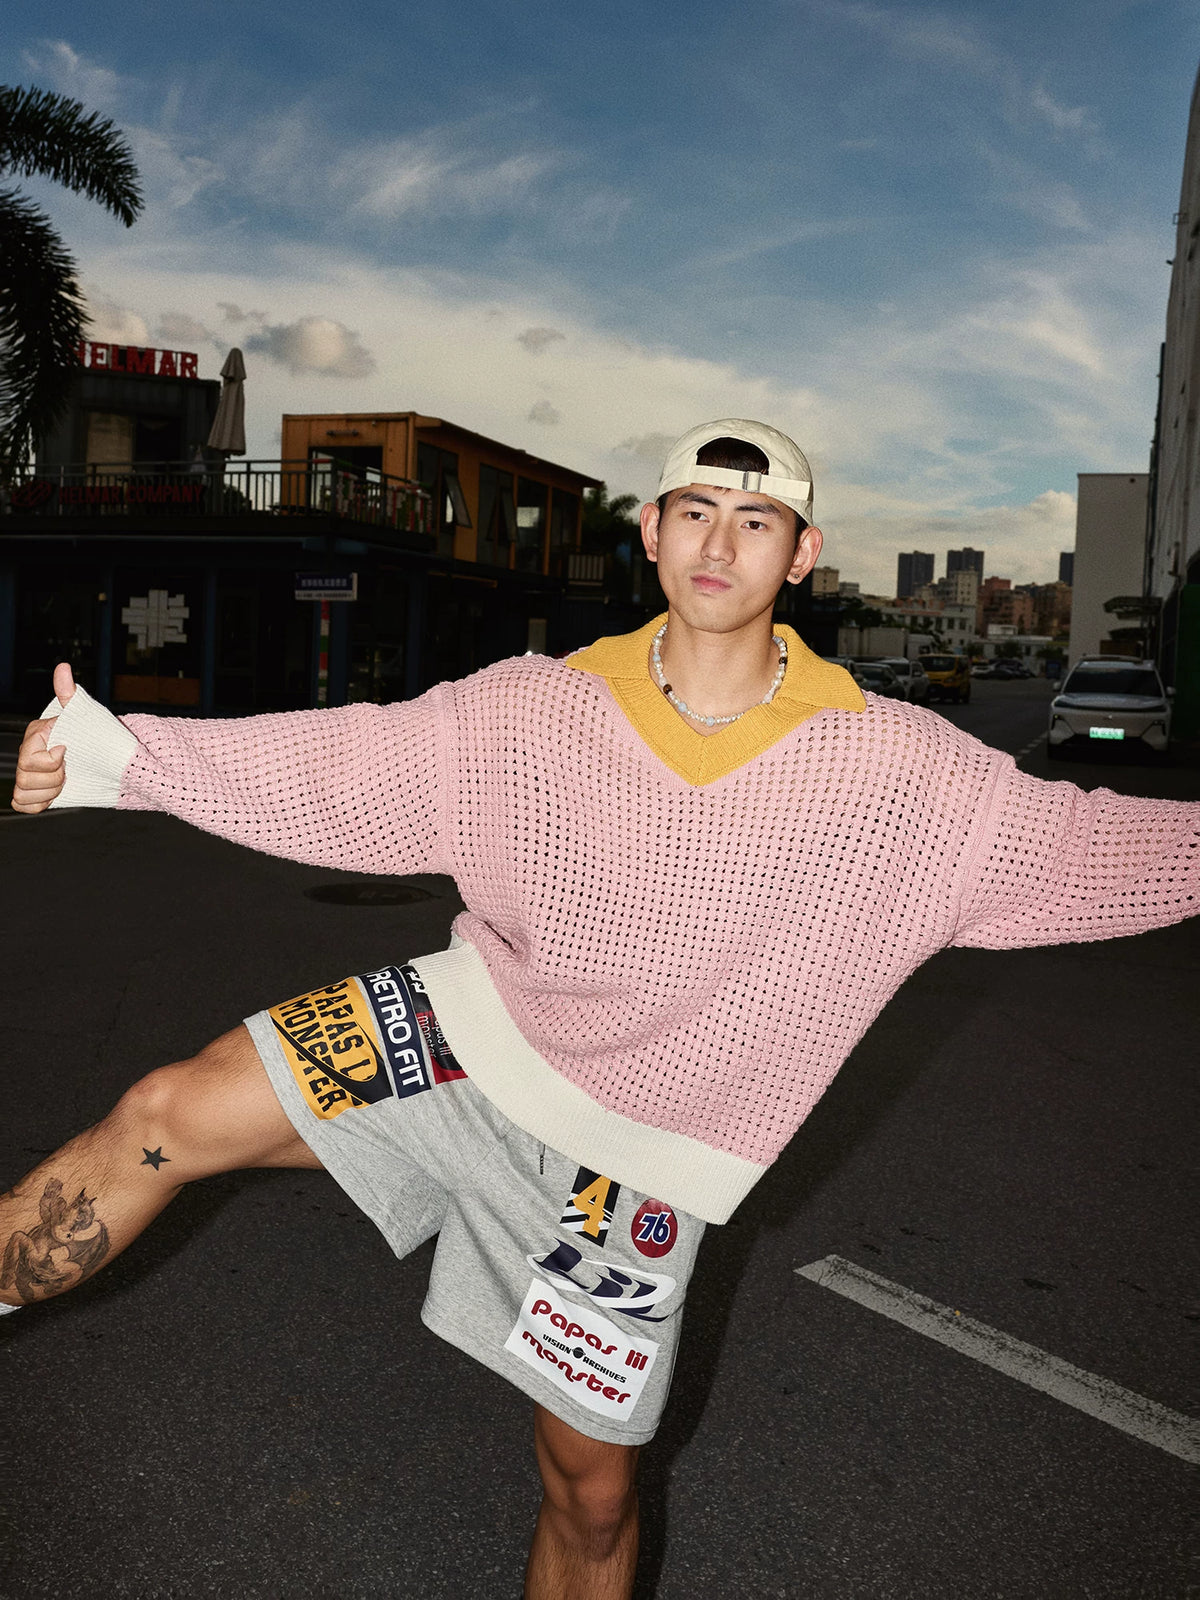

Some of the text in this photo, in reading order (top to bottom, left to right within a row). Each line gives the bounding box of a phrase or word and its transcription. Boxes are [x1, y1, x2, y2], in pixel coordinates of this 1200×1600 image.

[59, 484, 204, 504] HELMAR COMPANY
[311, 982, 365, 1054] PAPAS
[366, 970, 425, 1086] RETRO FIT
[572, 1175, 611, 1238] 4
[636, 1211, 671, 1245] 76
[522, 1331, 631, 1404] monster
[542, 1334, 627, 1384] VISION ARCHIVES
[625, 1349, 649, 1371] lil
